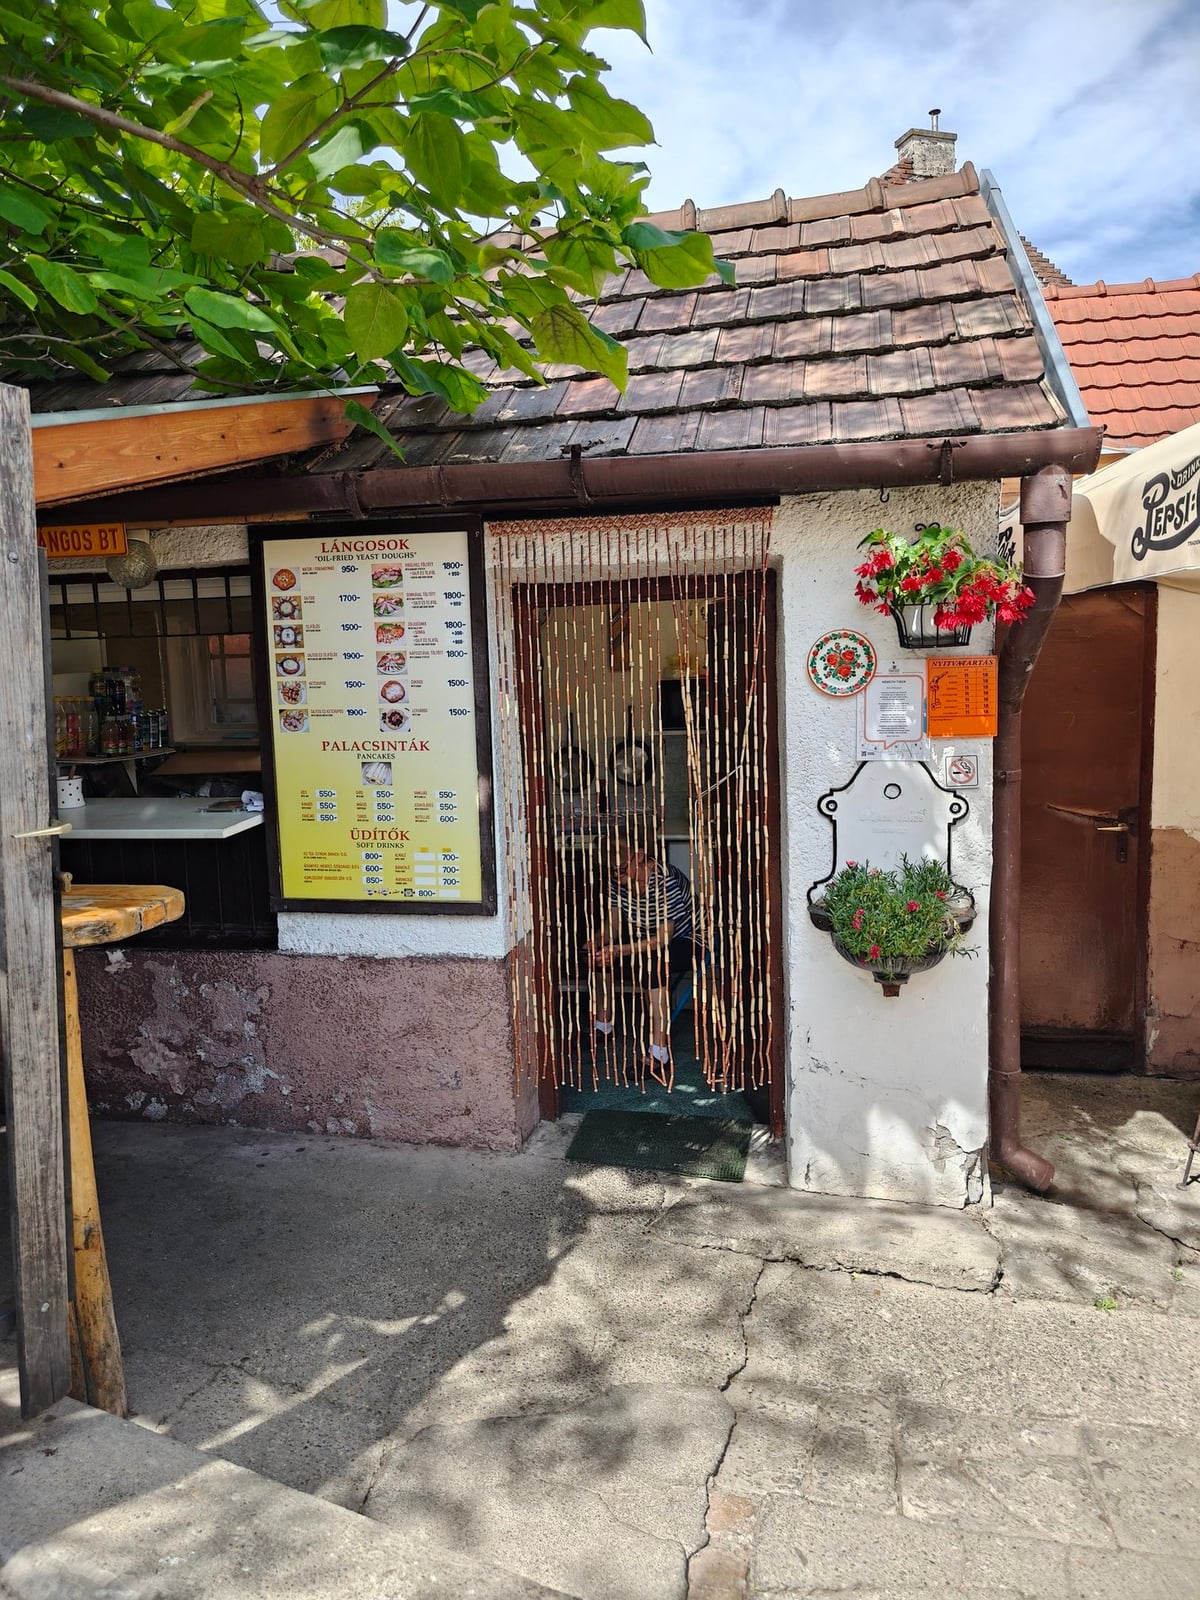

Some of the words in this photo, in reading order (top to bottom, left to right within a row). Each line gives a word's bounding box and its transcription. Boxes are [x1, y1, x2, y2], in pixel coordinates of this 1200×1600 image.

[98, 528, 118, 550] BT
[321, 539, 410, 553] LÁNGOSOK
[356, 553, 379, 561] YEAST
[321, 737, 430, 752] PALACSINTÁK
[350, 827, 410, 841] ÜDÍTŐK
